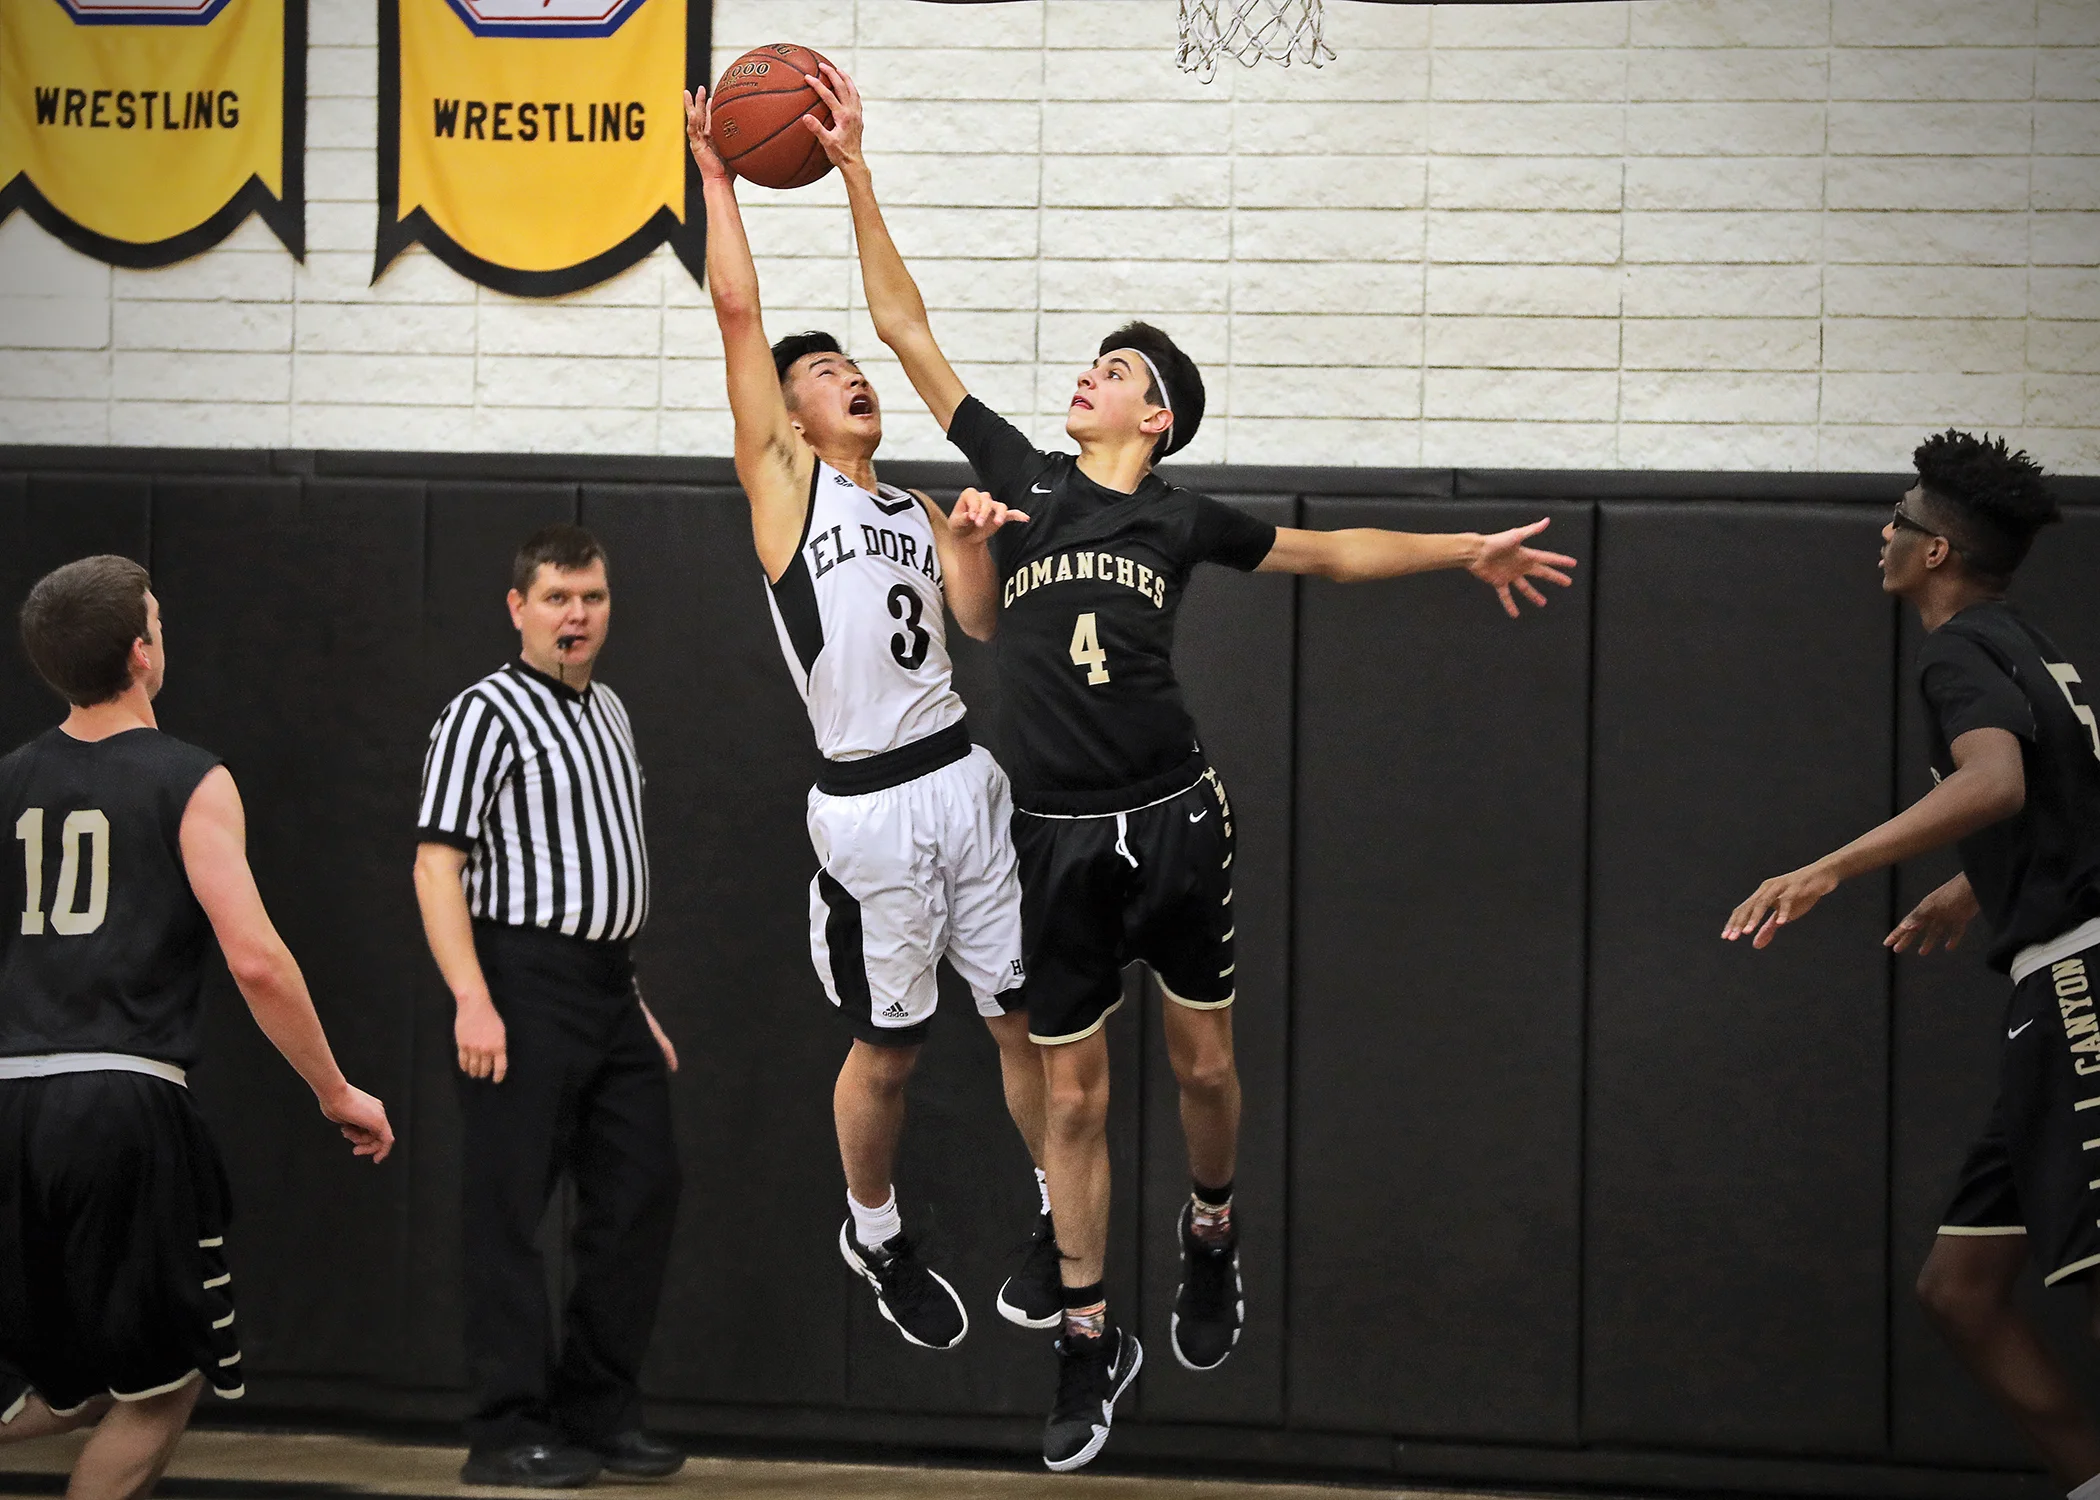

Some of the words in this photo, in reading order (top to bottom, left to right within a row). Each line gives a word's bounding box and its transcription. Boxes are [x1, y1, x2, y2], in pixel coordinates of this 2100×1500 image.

[34, 86, 239, 130] WRESTLING
[433, 98, 645, 142] WRESTLING
[809, 524, 856, 579] EL
[860, 523, 943, 592] DORA
[1004, 552, 1166, 609] COMANCHES
[887, 583, 930, 670] 3
[1069, 612, 1111, 686] 4
[15, 807, 110, 936] 10
[882, 1010, 909, 1018] adidas
[2051, 957, 2100, 1077] CANYON
